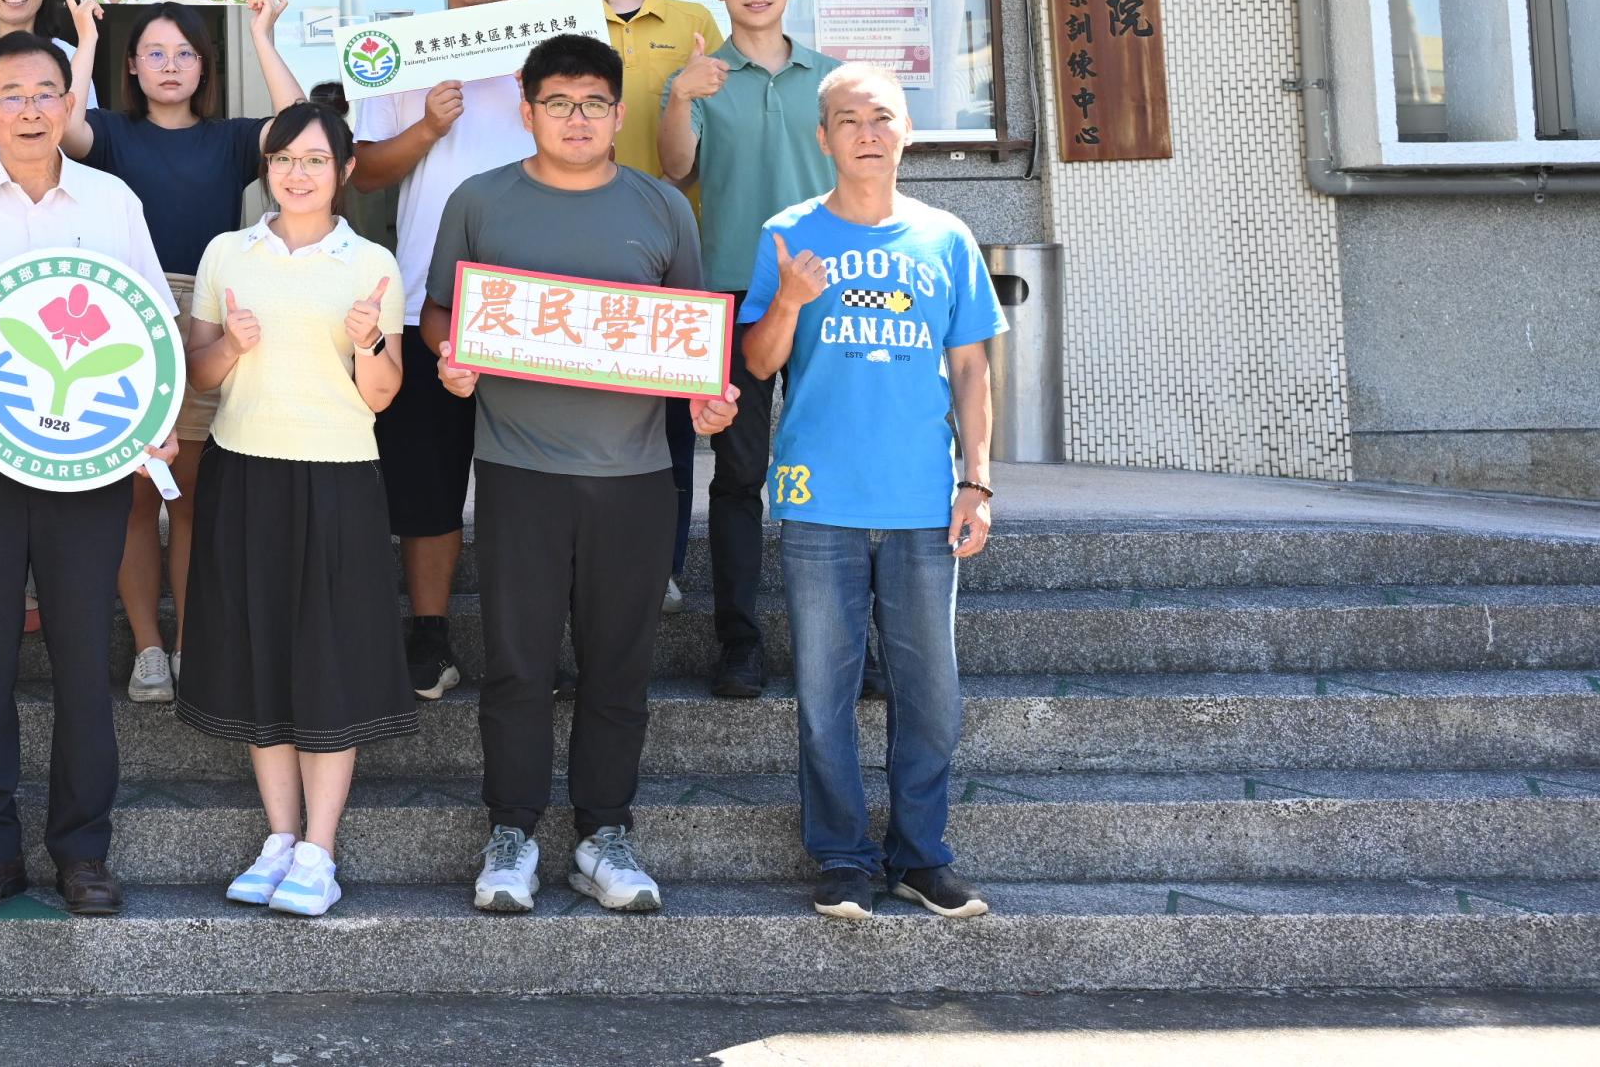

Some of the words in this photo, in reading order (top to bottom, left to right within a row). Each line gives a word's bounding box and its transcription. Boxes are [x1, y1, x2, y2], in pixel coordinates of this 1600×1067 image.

[404, 58, 426, 66] Taitung
[515, 41, 527, 49] and
[414, 15, 578, 55] 農業部臺東區農業改良場
[821, 248, 936, 298] ROOTS
[465, 278, 709, 358] 農民學院
[820, 316, 934, 350] CANADA
[463, 339, 502, 364] The
[510, 346, 603, 377] Farmers’
[607, 360, 709, 392] Academy
[895, 354, 911, 362] 1973
[38, 416, 71, 433] 1928
[30, 460, 101, 478] DARES,
[105, 437, 145, 468] MOA
